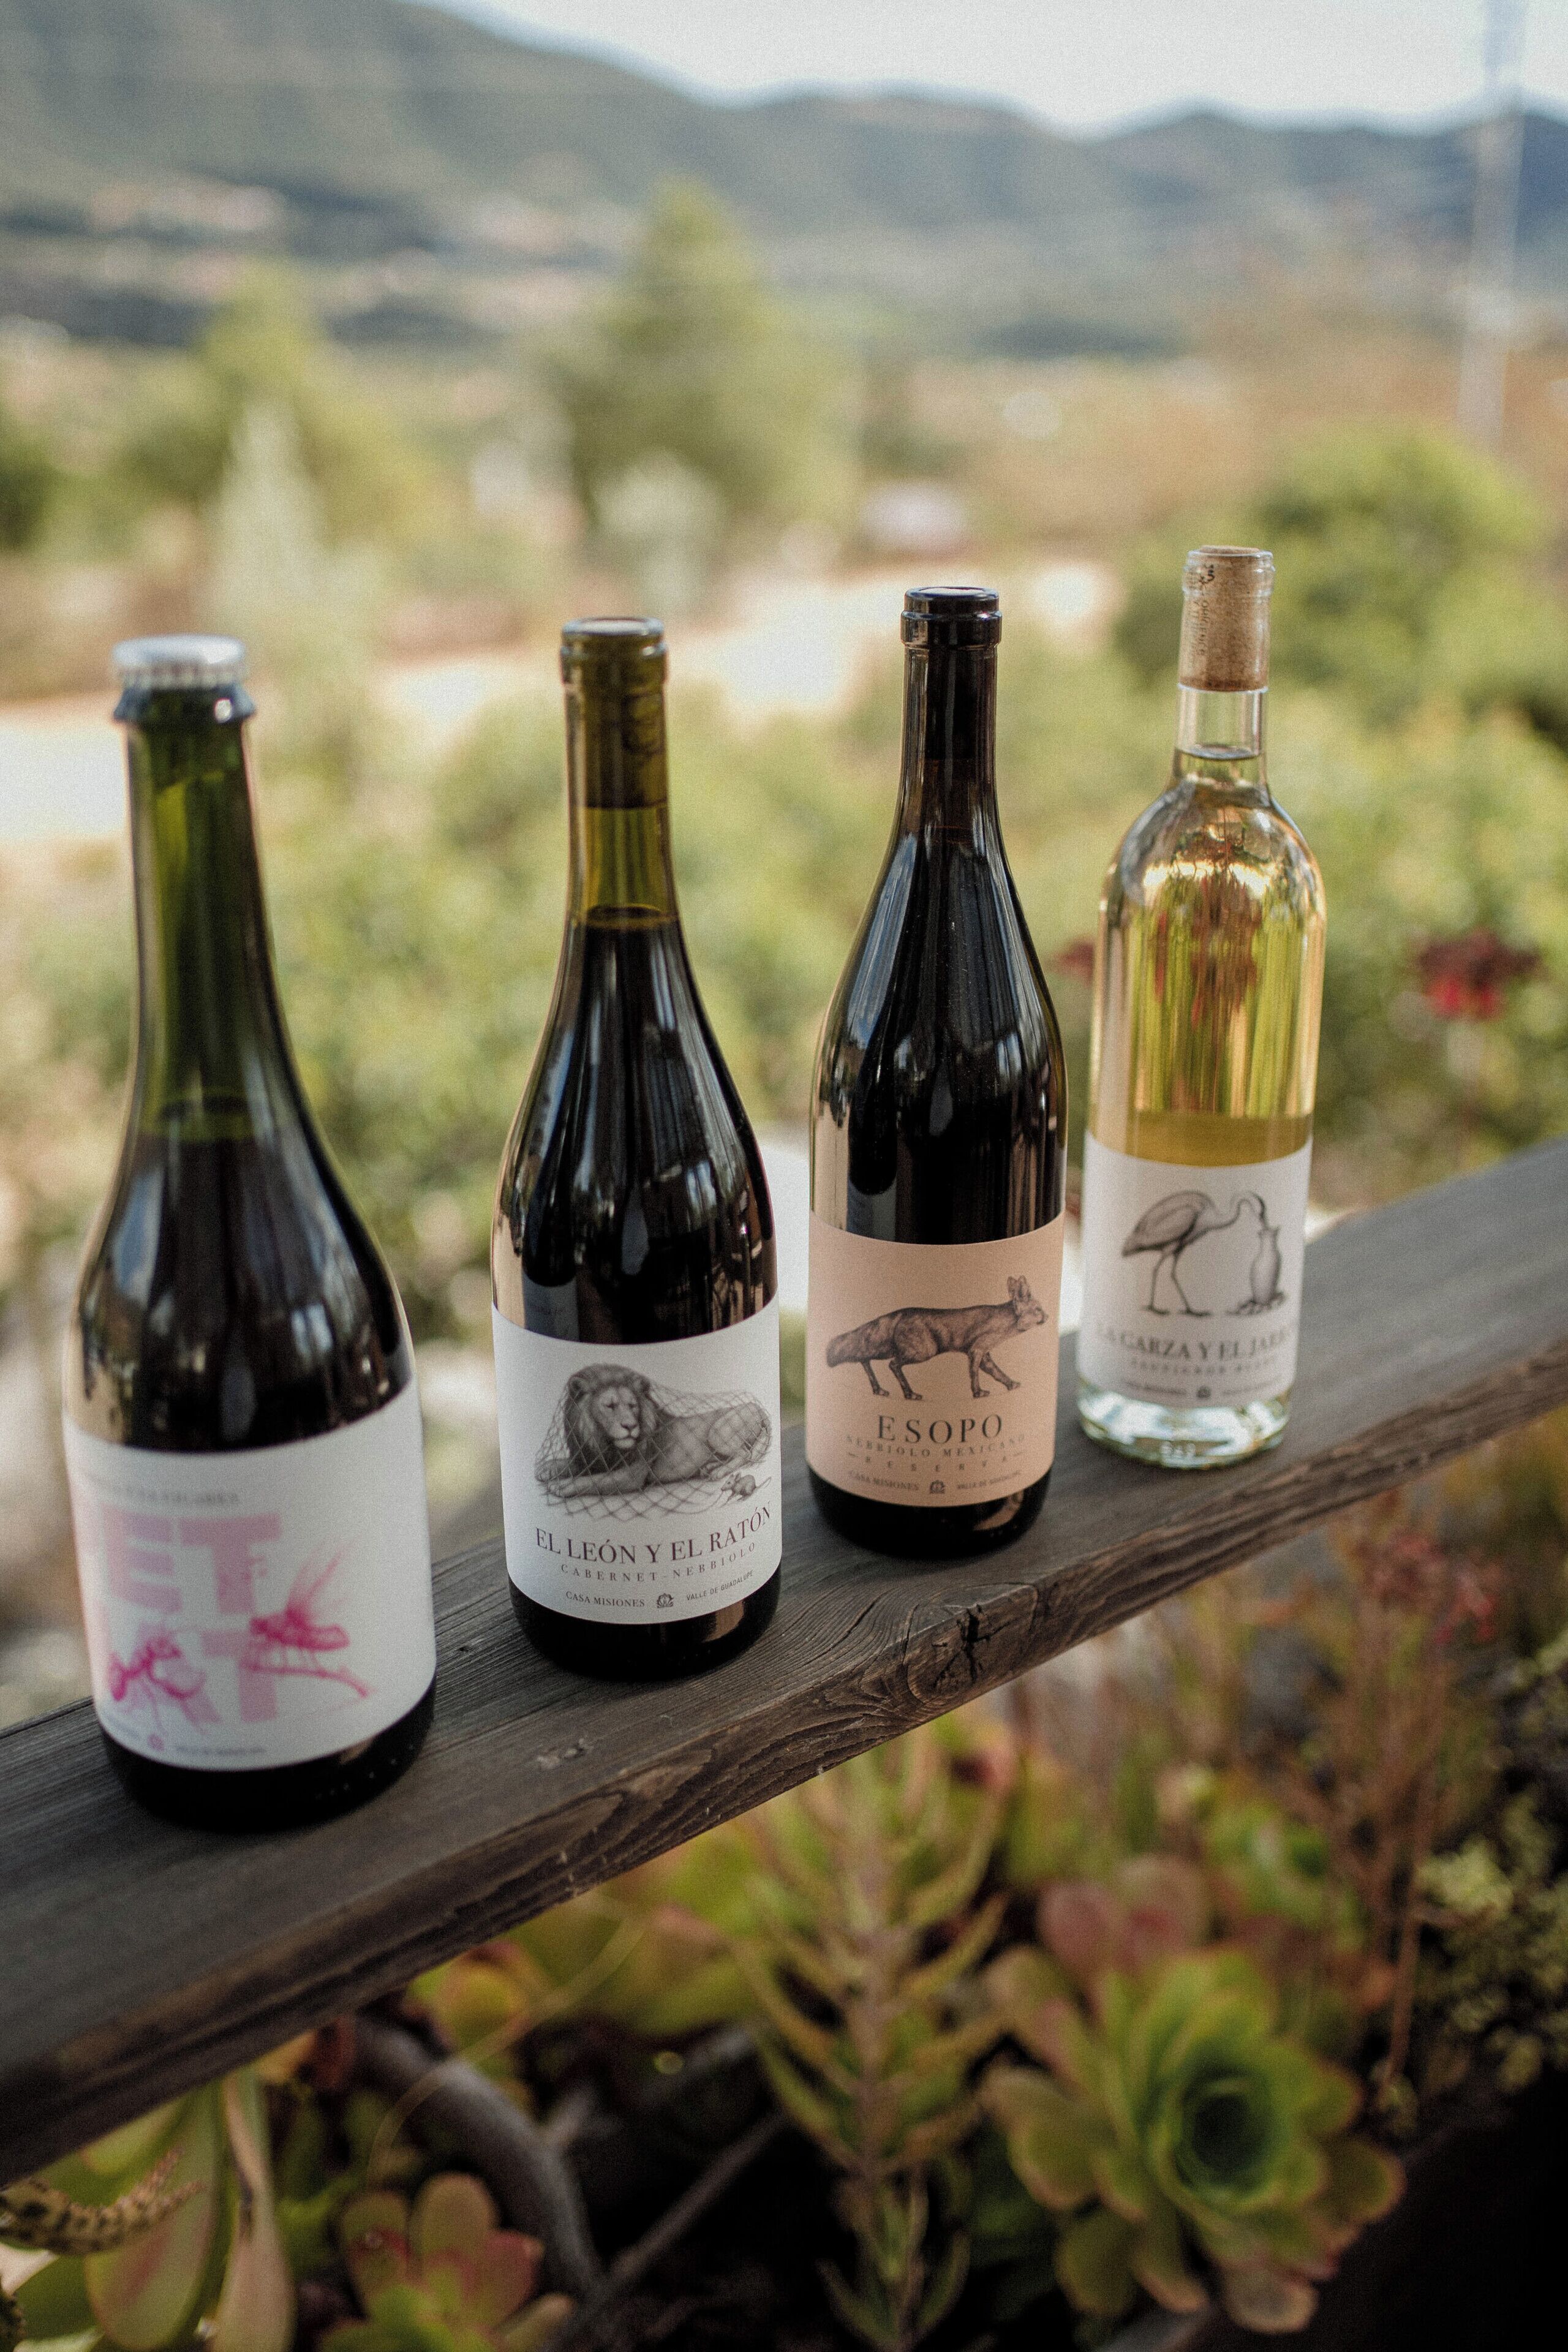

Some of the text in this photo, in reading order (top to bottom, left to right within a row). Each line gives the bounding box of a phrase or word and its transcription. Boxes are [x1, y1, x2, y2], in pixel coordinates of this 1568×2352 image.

[1198, 1341, 1212, 1360] Y
[878, 1414, 1002, 1444] ESOPO
[846, 1433, 1025, 1458] NEBBIOLO MEXICANO
[865, 1455, 1008, 1472] RESERVA
[872, 1477, 920, 1491] MISIONES
[536, 1500, 771, 1564] EL LEÓN Y EL RATÓN
[565, 1591, 591, 1604] CASA
[594, 1596, 646, 1608] MISIONES
[685, 1590, 707, 1601] VALLE
[720, 1570, 753, 1591] GUADALUPE
